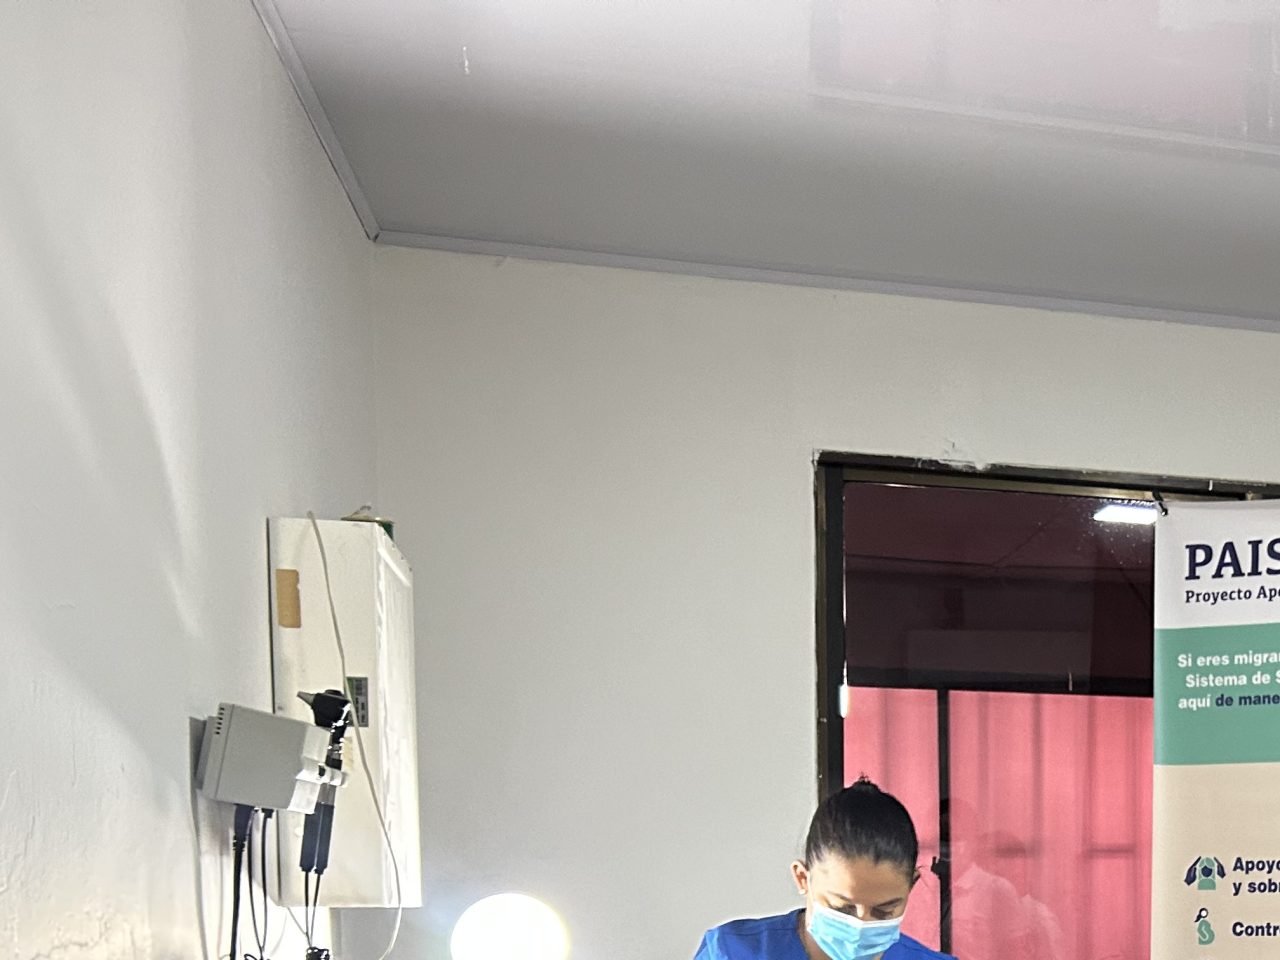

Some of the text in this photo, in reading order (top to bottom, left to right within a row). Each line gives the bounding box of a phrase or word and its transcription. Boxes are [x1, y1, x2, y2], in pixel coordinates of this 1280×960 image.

[1185, 589, 1252, 605] Proyecto
[1178, 653, 1192, 668] Si
[1197, 654, 1229, 666] eres
[1185, 671, 1247, 688] Sistema
[1252, 671, 1271, 684] de
[1178, 694, 1211, 711] aquí
[1215, 693, 1234, 707] de
[1232, 881, 1242, 897] y
